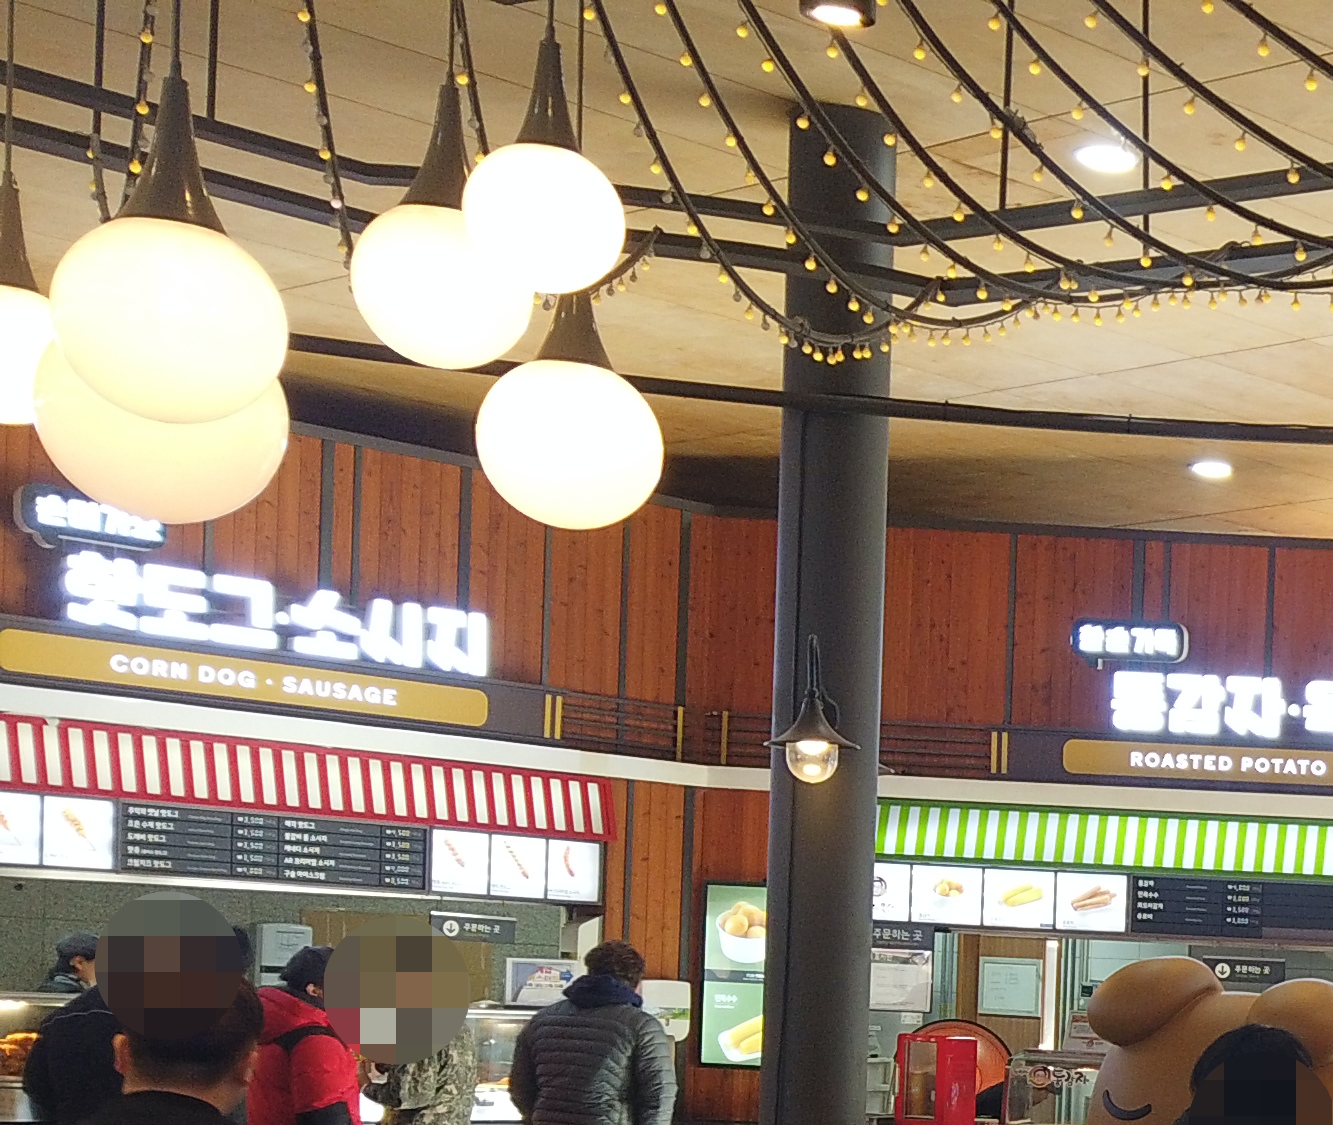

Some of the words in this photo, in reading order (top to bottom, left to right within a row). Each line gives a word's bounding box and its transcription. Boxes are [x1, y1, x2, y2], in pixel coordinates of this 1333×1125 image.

[109, 653, 189, 682] CORN
[197, 664, 258, 690] DOG
[281, 676, 398, 707] SAUSAGE
[1129, 750, 1234, 773] ROASTED
[1240, 755, 1326, 777] POTATO
[872, 927, 911, 942] 주문하는
[912, 929, 923, 942] 곳
